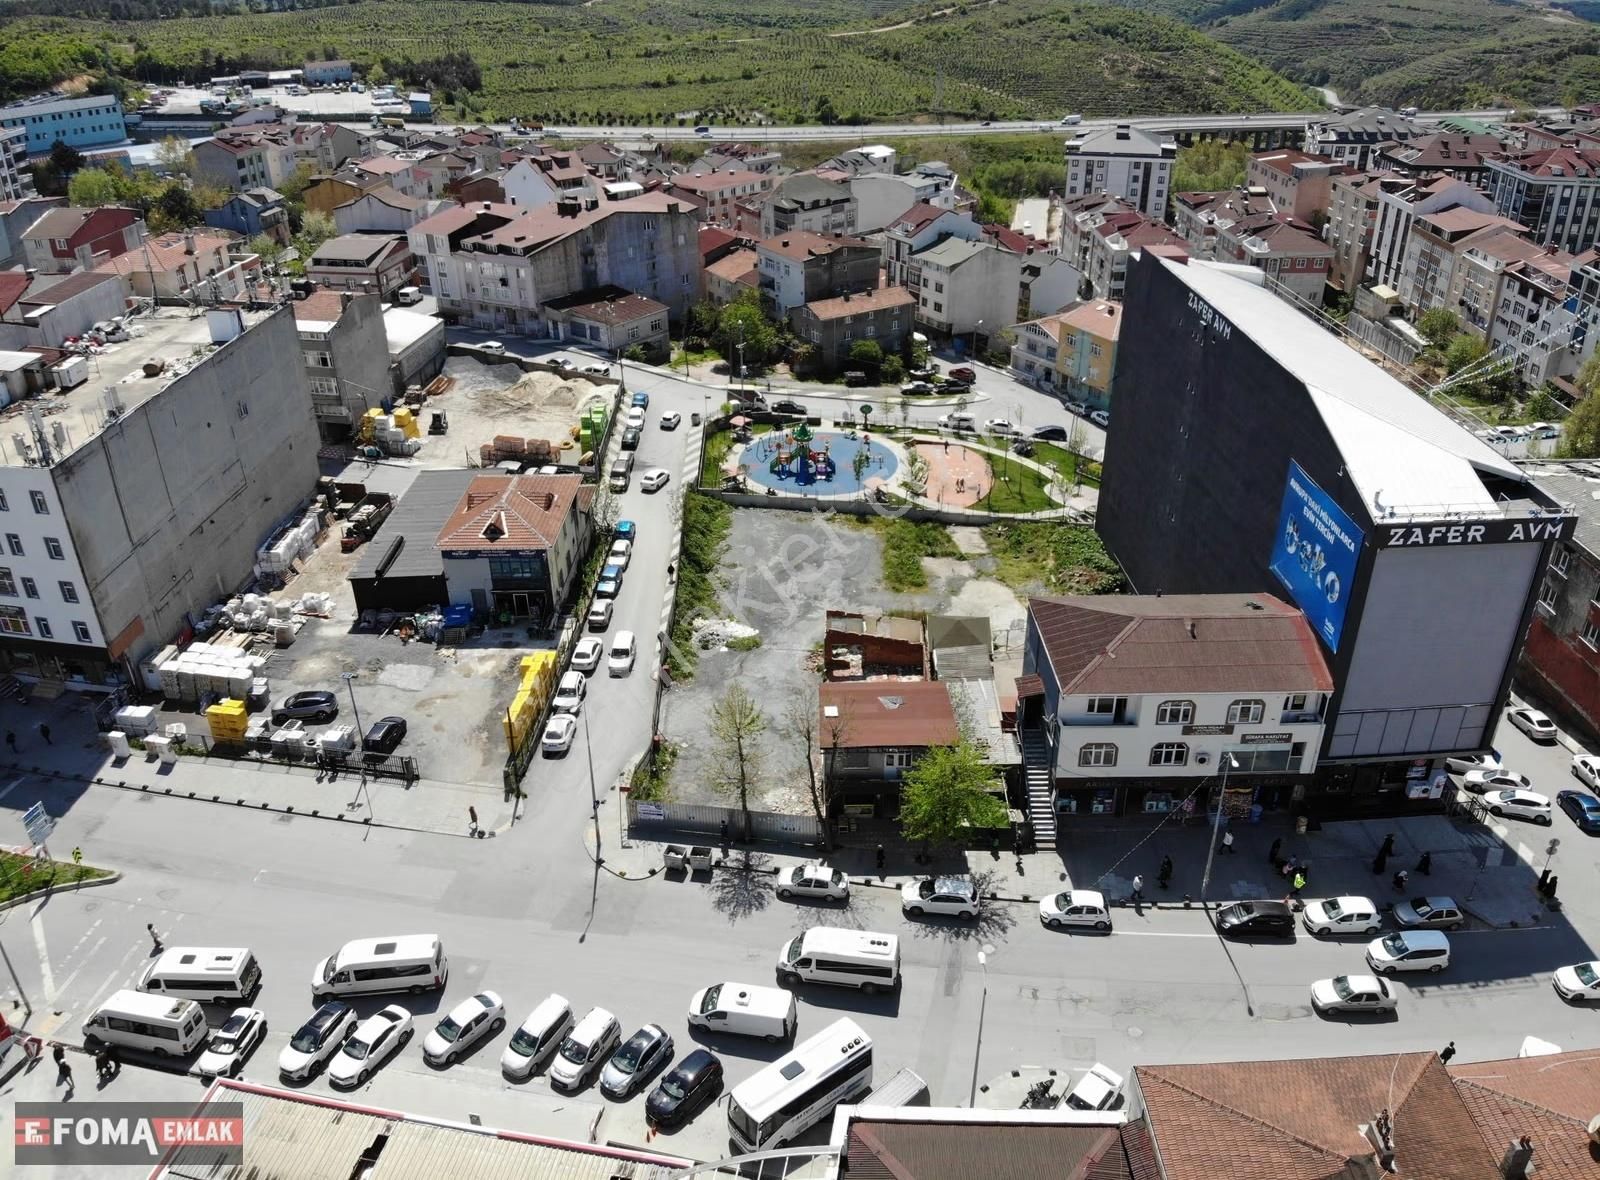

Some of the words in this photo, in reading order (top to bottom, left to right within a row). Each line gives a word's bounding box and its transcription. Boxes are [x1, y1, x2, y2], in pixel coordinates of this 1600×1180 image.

[1188, 291, 1213, 325] ZAFER
[1213, 314, 1231, 340] AVM
[1388, 525, 1485, 546] ZAFER
[1508, 522, 1563, 541] AVM
